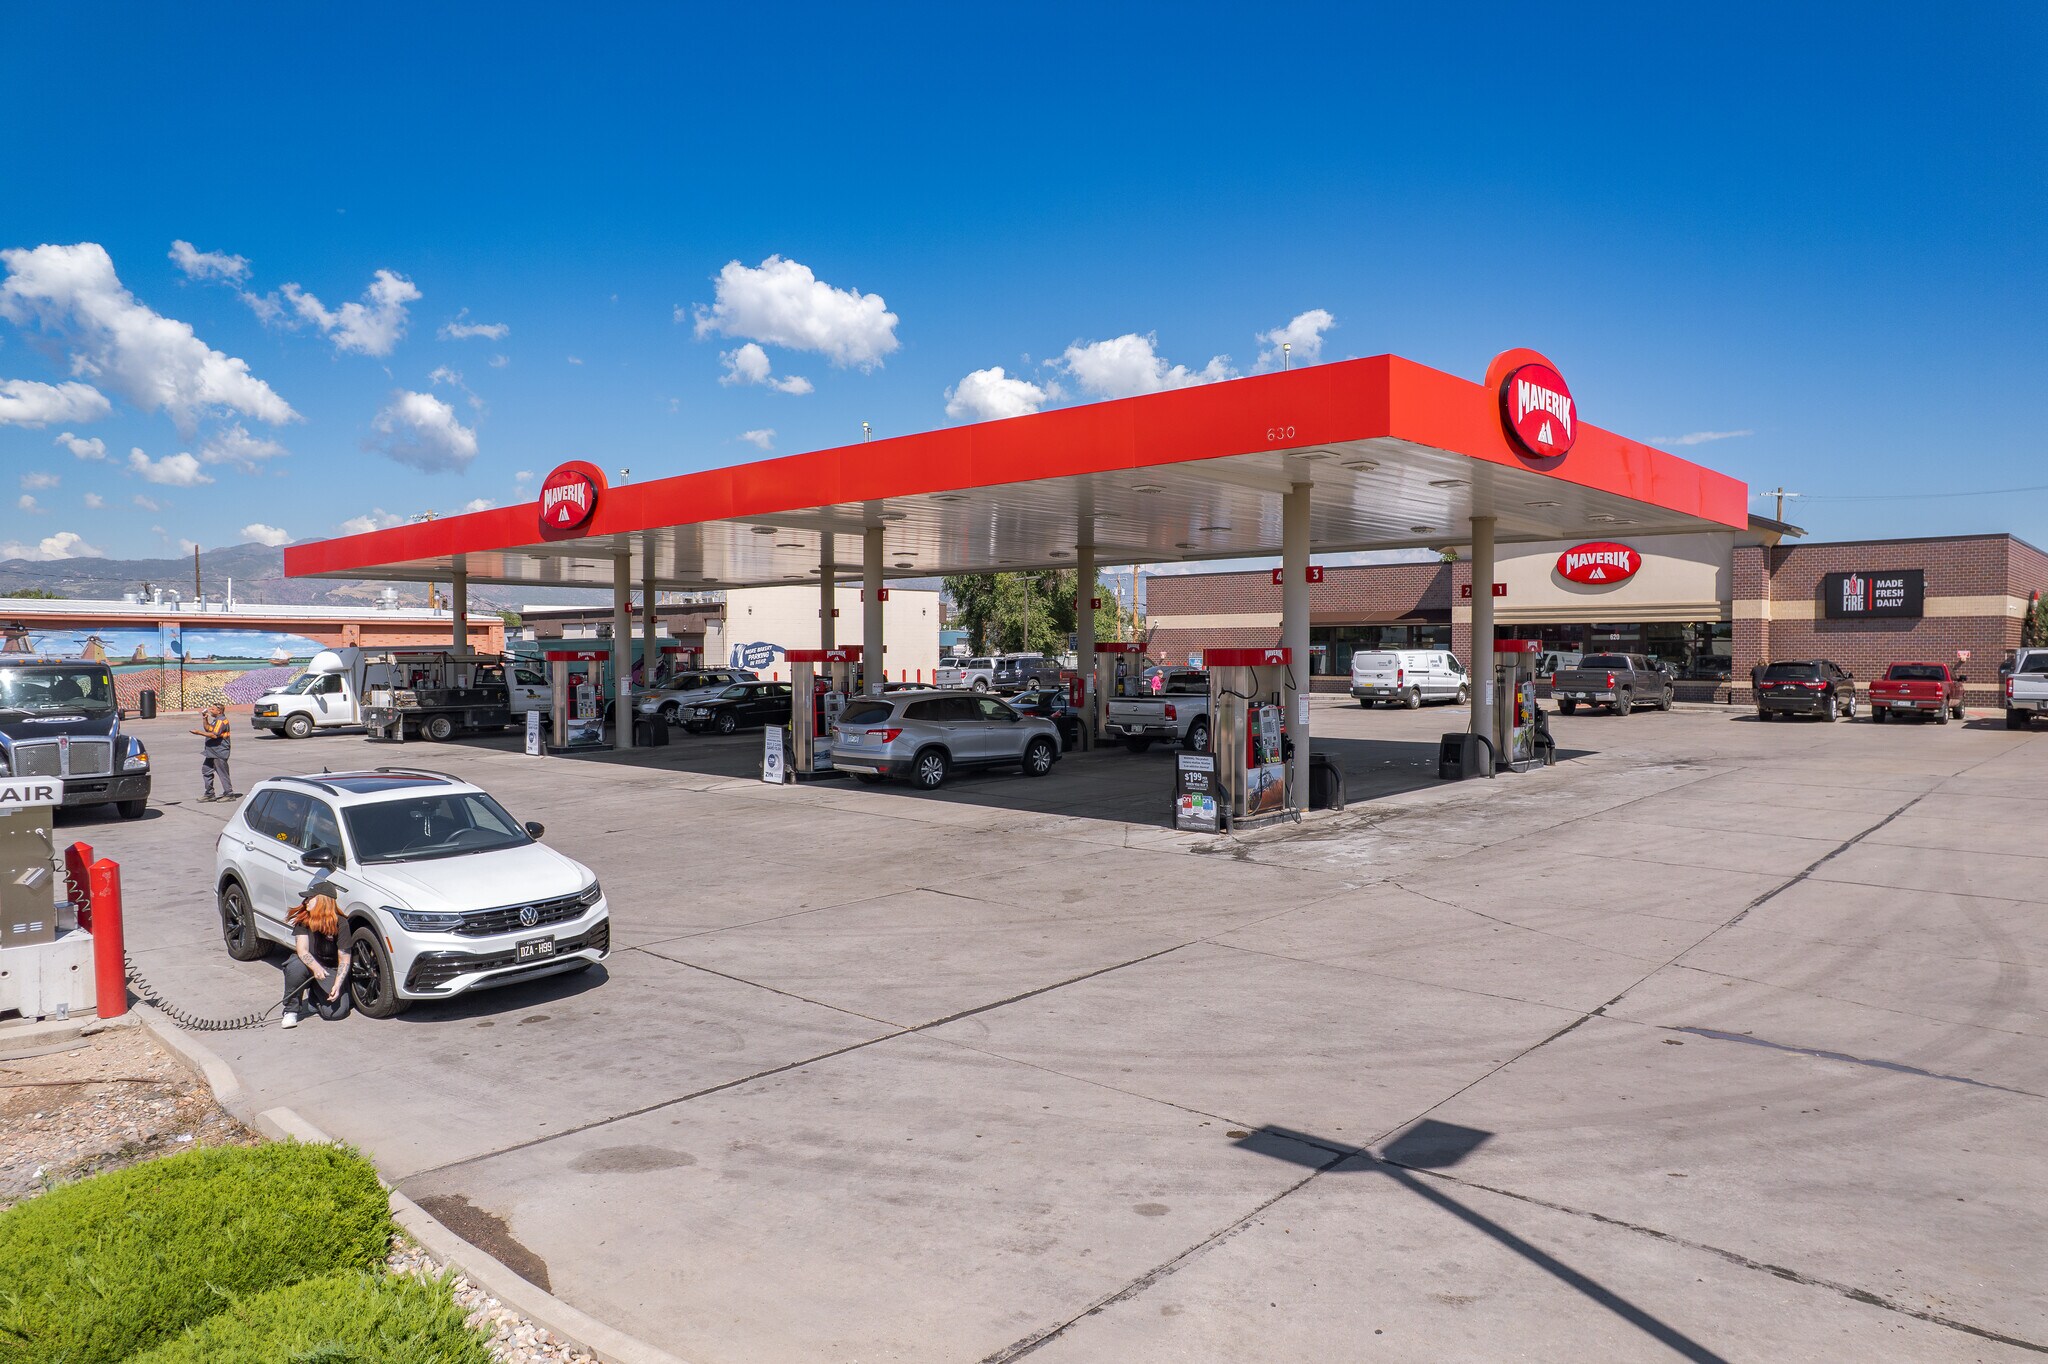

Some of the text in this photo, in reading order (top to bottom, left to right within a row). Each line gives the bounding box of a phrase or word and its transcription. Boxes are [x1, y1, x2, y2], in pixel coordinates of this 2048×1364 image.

[1517, 378, 1572, 441] MAVERIK
[1267, 426, 1295, 441] 630
[544, 482, 586, 518] MAVERIK
[1566, 551, 1630, 575] MAVERIK
[1276, 571, 1283, 582] 4
[1312, 569, 1319, 580] 3
[1876, 580, 1904, 588] MADE
[882, 591, 887, 599] 7
[1465, 587, 1471, 596] 2
[1875, 589, 1904, 598] FRESH
[1876, 598, 1904, 607] DAILY
[747, 651, 770, 661] PARKING
[0, 786, 54, 802] AIR
